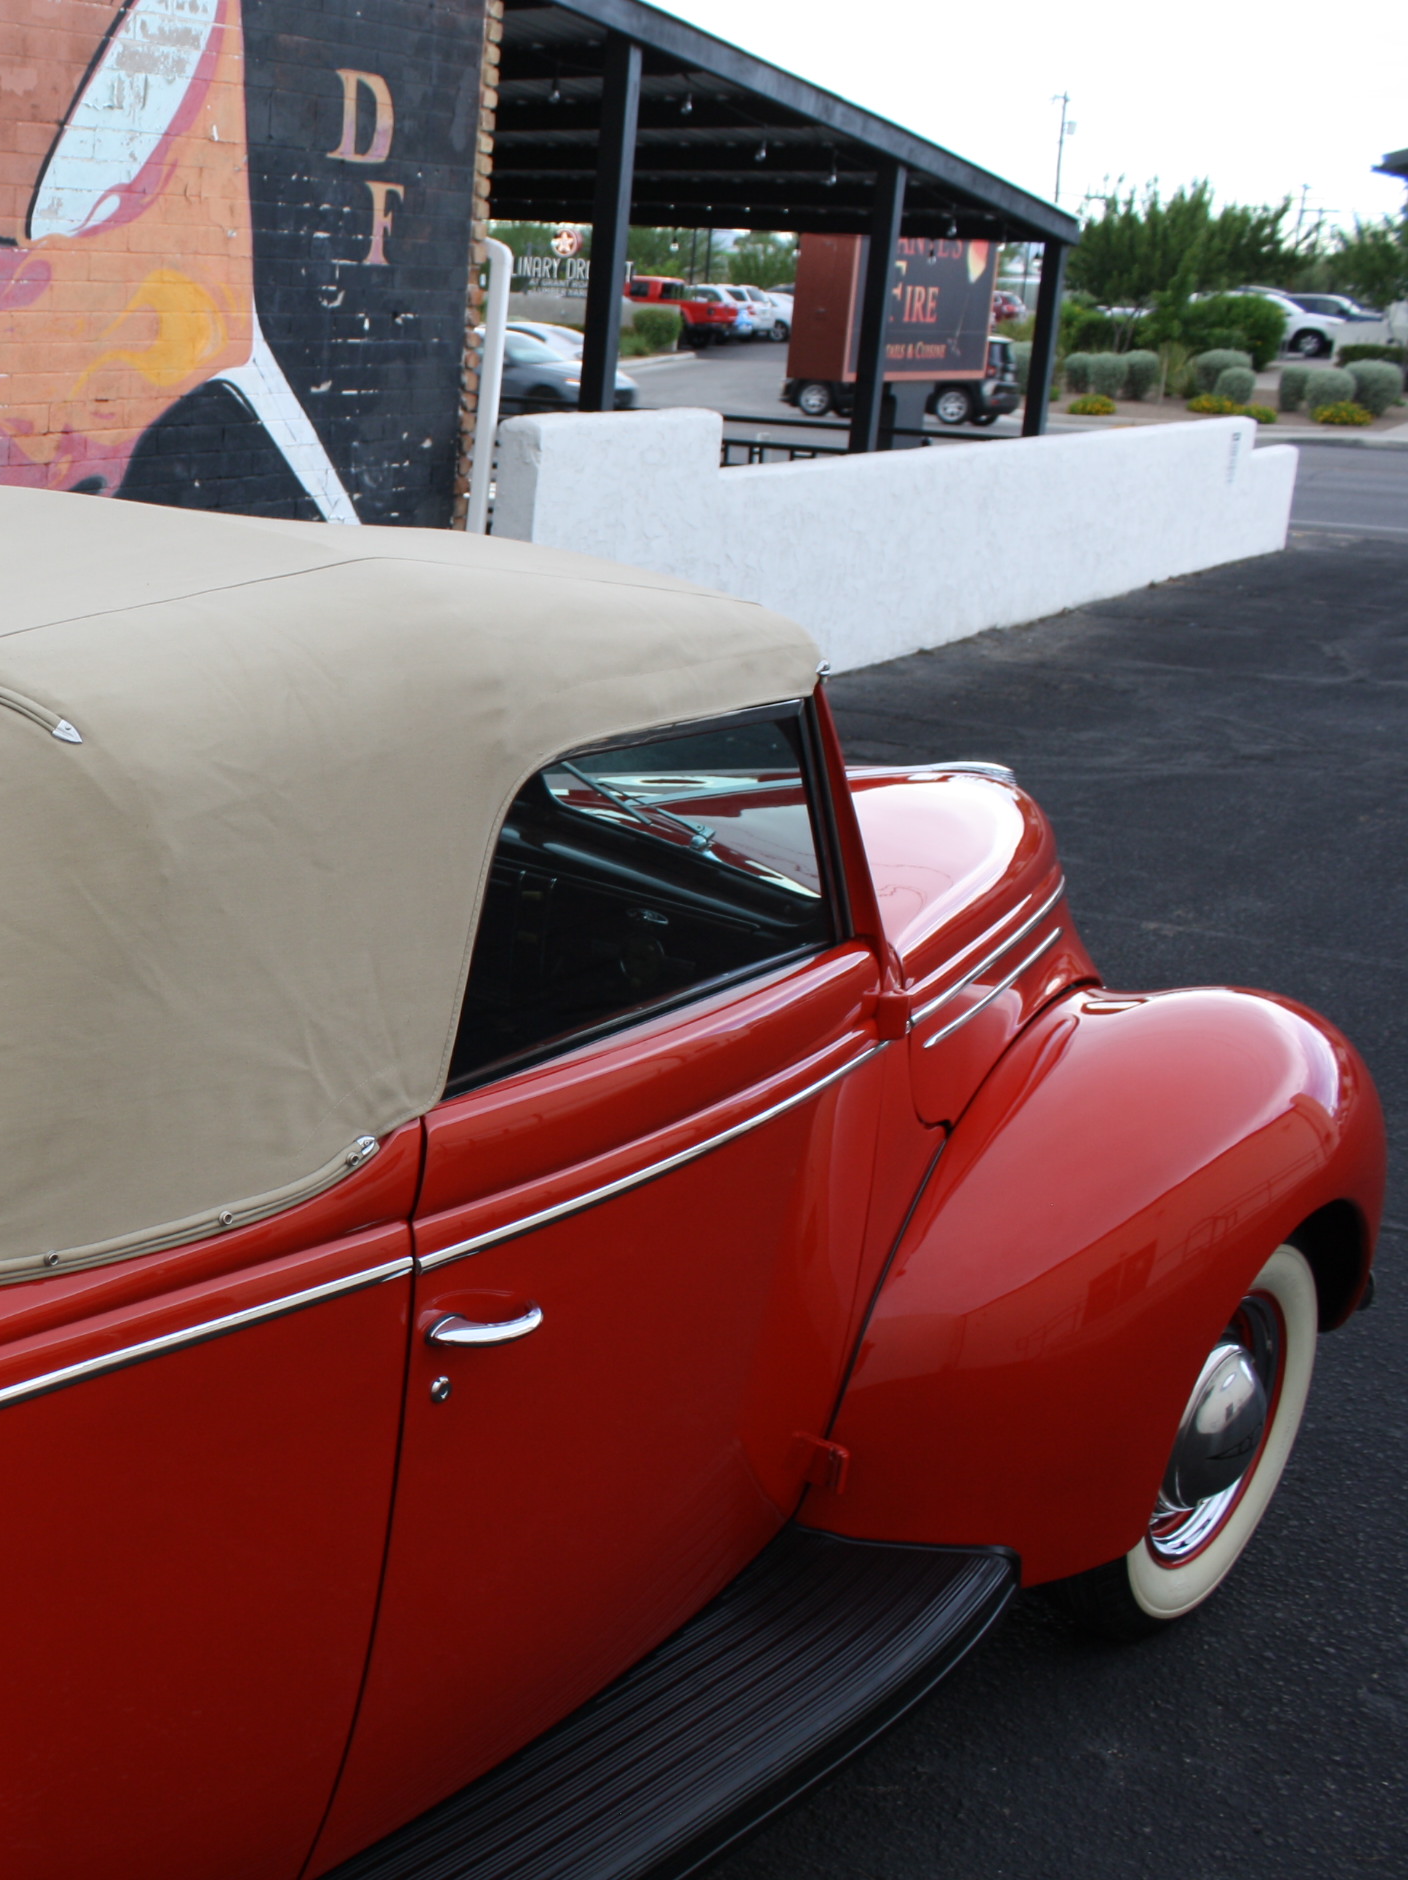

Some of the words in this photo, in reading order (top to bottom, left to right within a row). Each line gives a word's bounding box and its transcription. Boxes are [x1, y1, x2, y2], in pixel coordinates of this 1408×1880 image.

[326, 68, 394, 164] D
[365, 180, 404, 265] F
[511, 256, 561, 279] LINARY
